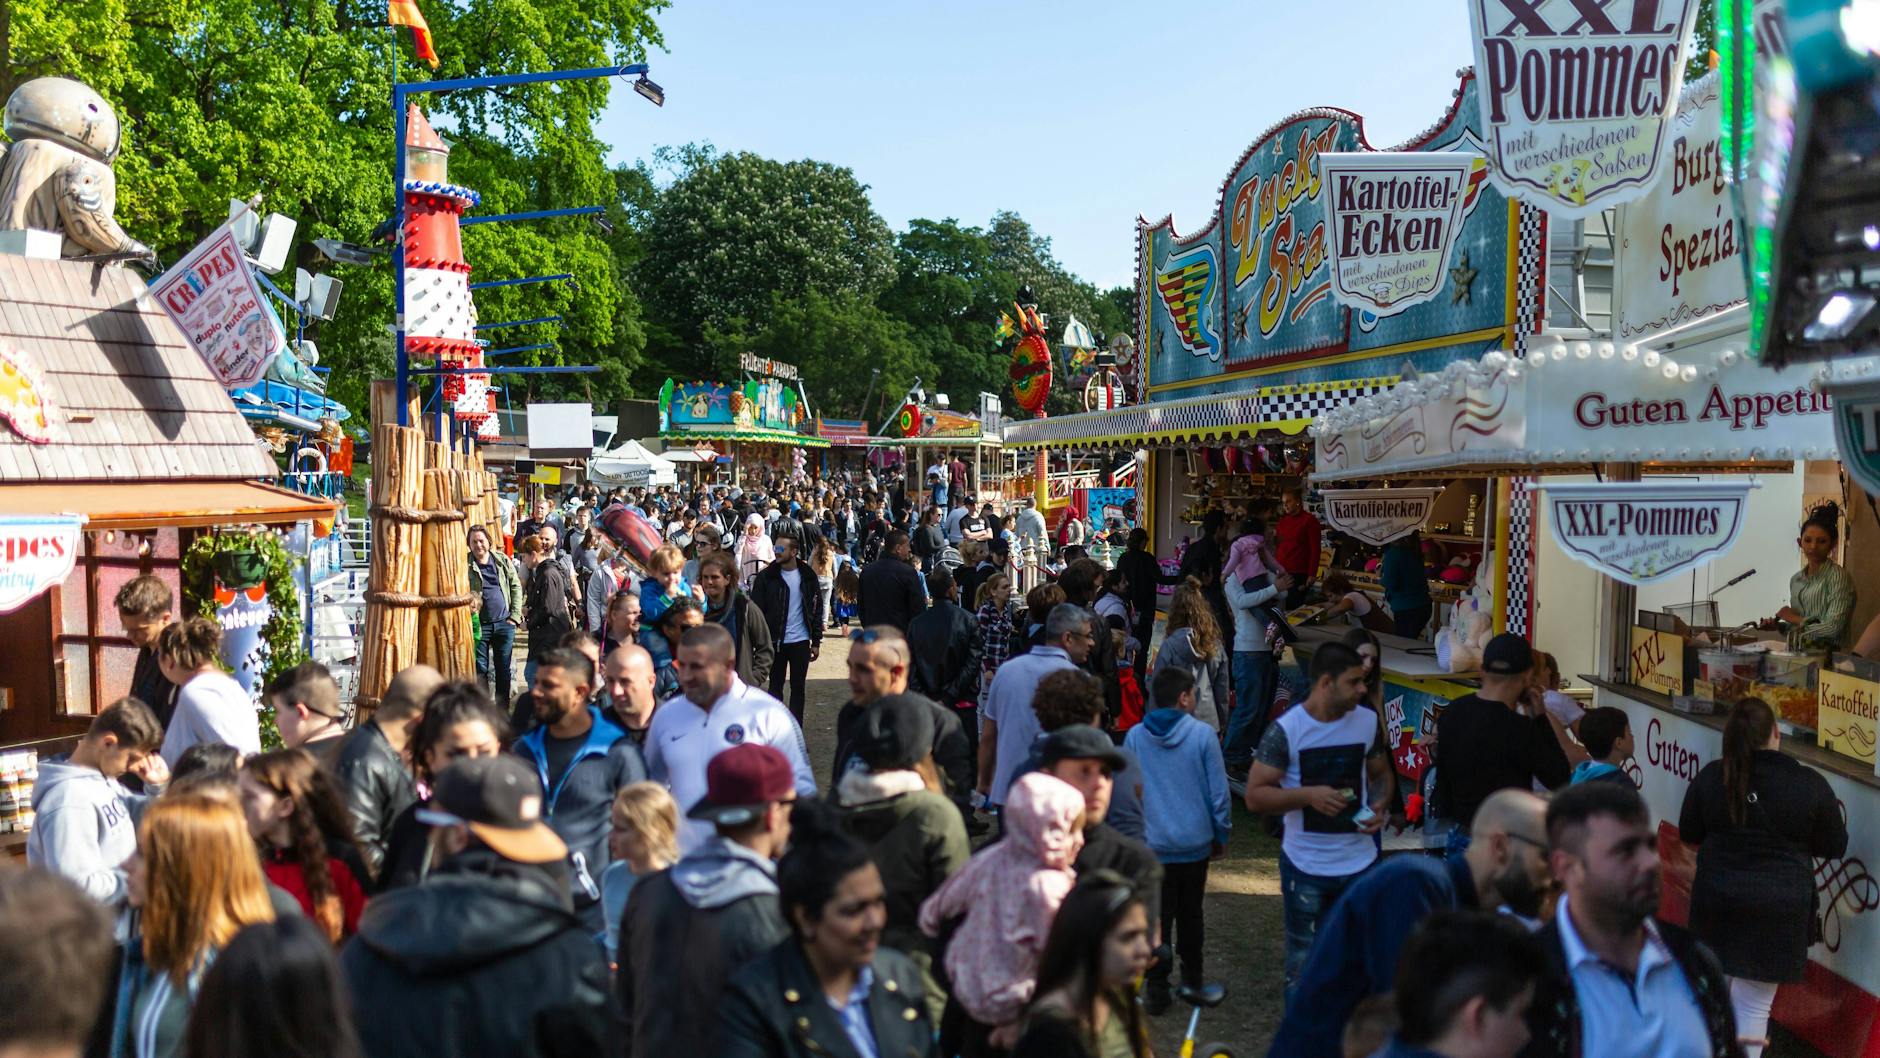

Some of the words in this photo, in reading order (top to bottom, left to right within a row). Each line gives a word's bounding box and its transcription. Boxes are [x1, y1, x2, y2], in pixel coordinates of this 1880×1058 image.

[1496, 0, 1676, 36] XXL
[1484, 38, 1679, 123] Pommes
[1506, 130, 1536, 154] mit
[1514, 125, 1638, 173] verschiedenen
[1591, 148, 1647, 181] Soßen
[1231, 121, 1339, 288] Lucky
[1338, 175, 1458, 211] Kartoffel-
[1340, 213, 1443, 258] Ecken
[1660, 205, 1744, 297] Spezia
[1260, 213, 1329, 335] Sta
[1343, 261, 1361, 278] mit
[1348, 258, 1427, 289] verschiedenen
[1395, 273, 1431, 293] Dips
[195, 321, 222, 345] duplo
[225, 299, 255, 333] nutella
[1576, 393, 1688, 428] Guten
[1699, 384, 1833, 430] Appetit
[1334, 501, 1423, 518] Kartoffelecken
[1564, 503, 1720, 537] XXL-Pommes
[0, 537, 64, 562] pes
[1632, 631, 1665, 680] XXL
[1650, 664, 1681, 690] Pommes
[1647, 718, 1699, 781] Guten
